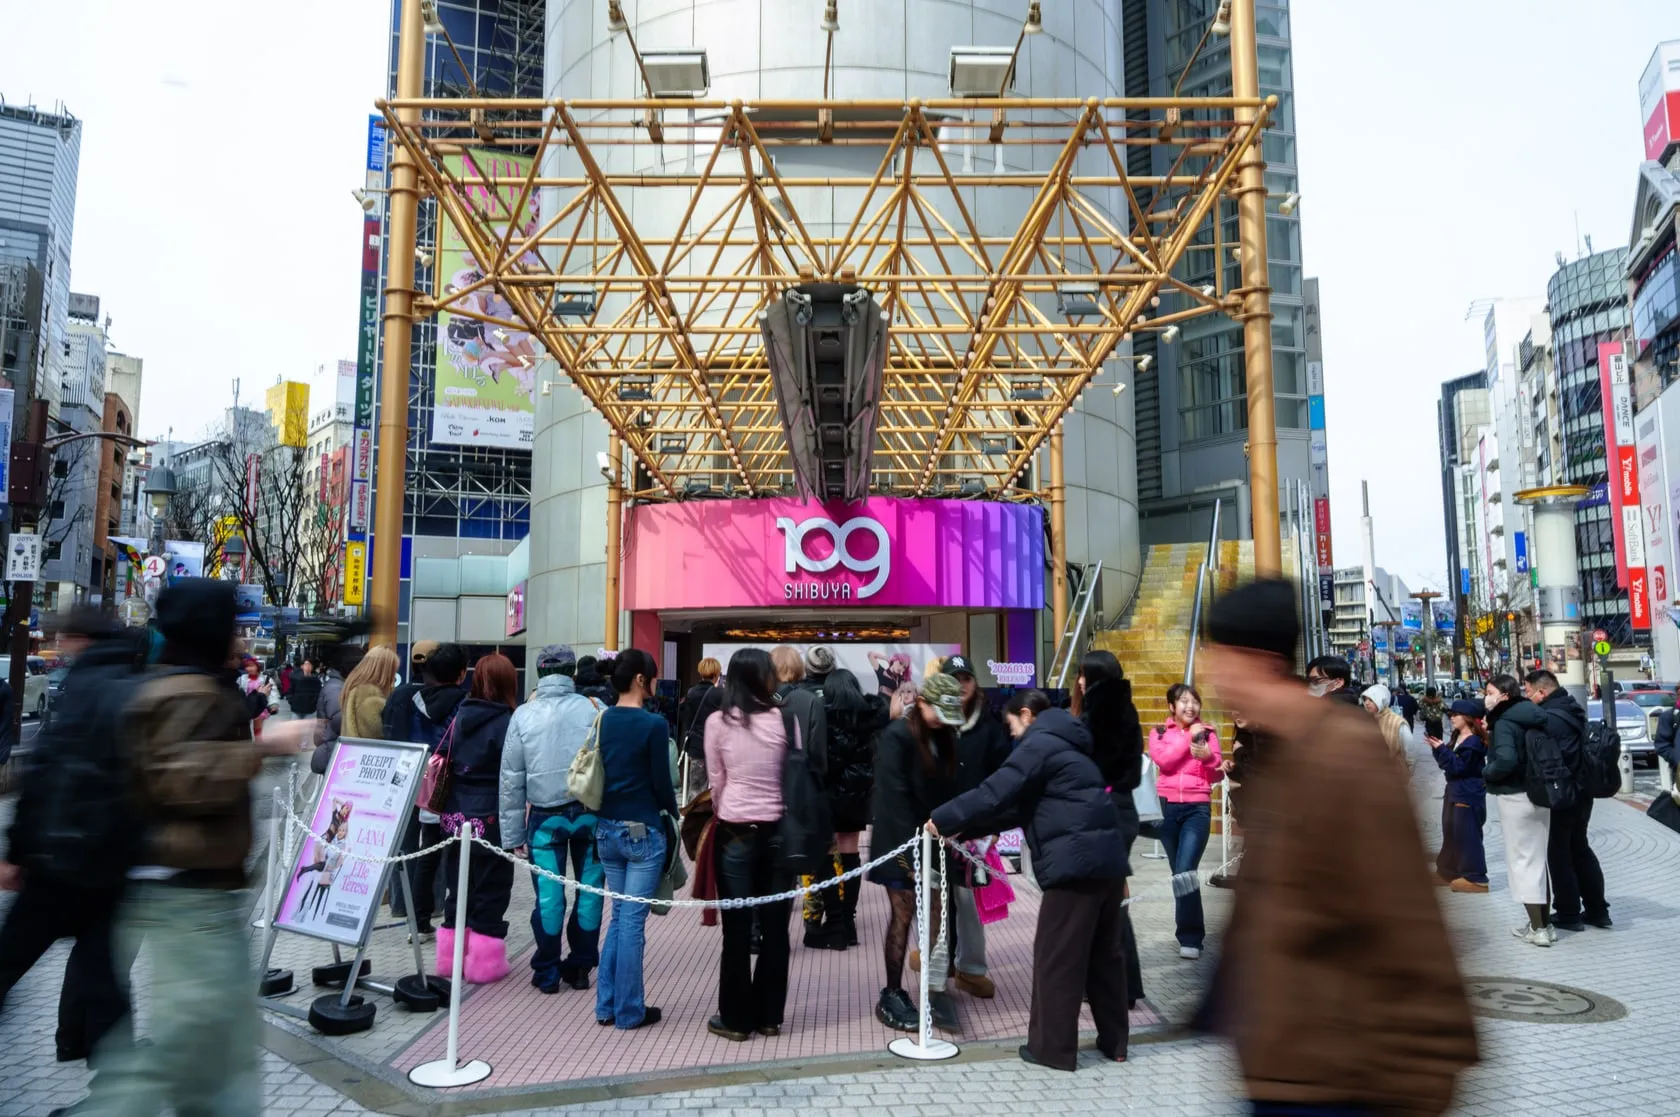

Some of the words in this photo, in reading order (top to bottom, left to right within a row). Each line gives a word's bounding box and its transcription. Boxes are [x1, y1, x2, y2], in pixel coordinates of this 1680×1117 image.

[1620, 396, 1630, 428] DANCE
[359, 438, 370, 472] カラオケ
[1622, 455, 1633, 497] Y!mobile
[1646, 503, 1662, 533] Y!
[776, 516, 891, 600] 109
[1628, 523, 1640, 563] SoftBank
[147, 559, 158, 573] 4
[783, 582, 851, 600] SHIBUYA
[1632, 577, 1643, 619] Y!mobile
[358, 767, 387, 780] PHOTO
[360, 754, 396, 769] RECEIPT
[356, 827, 386, 847] LANA
[340, 875, 369, 896] Teresa
